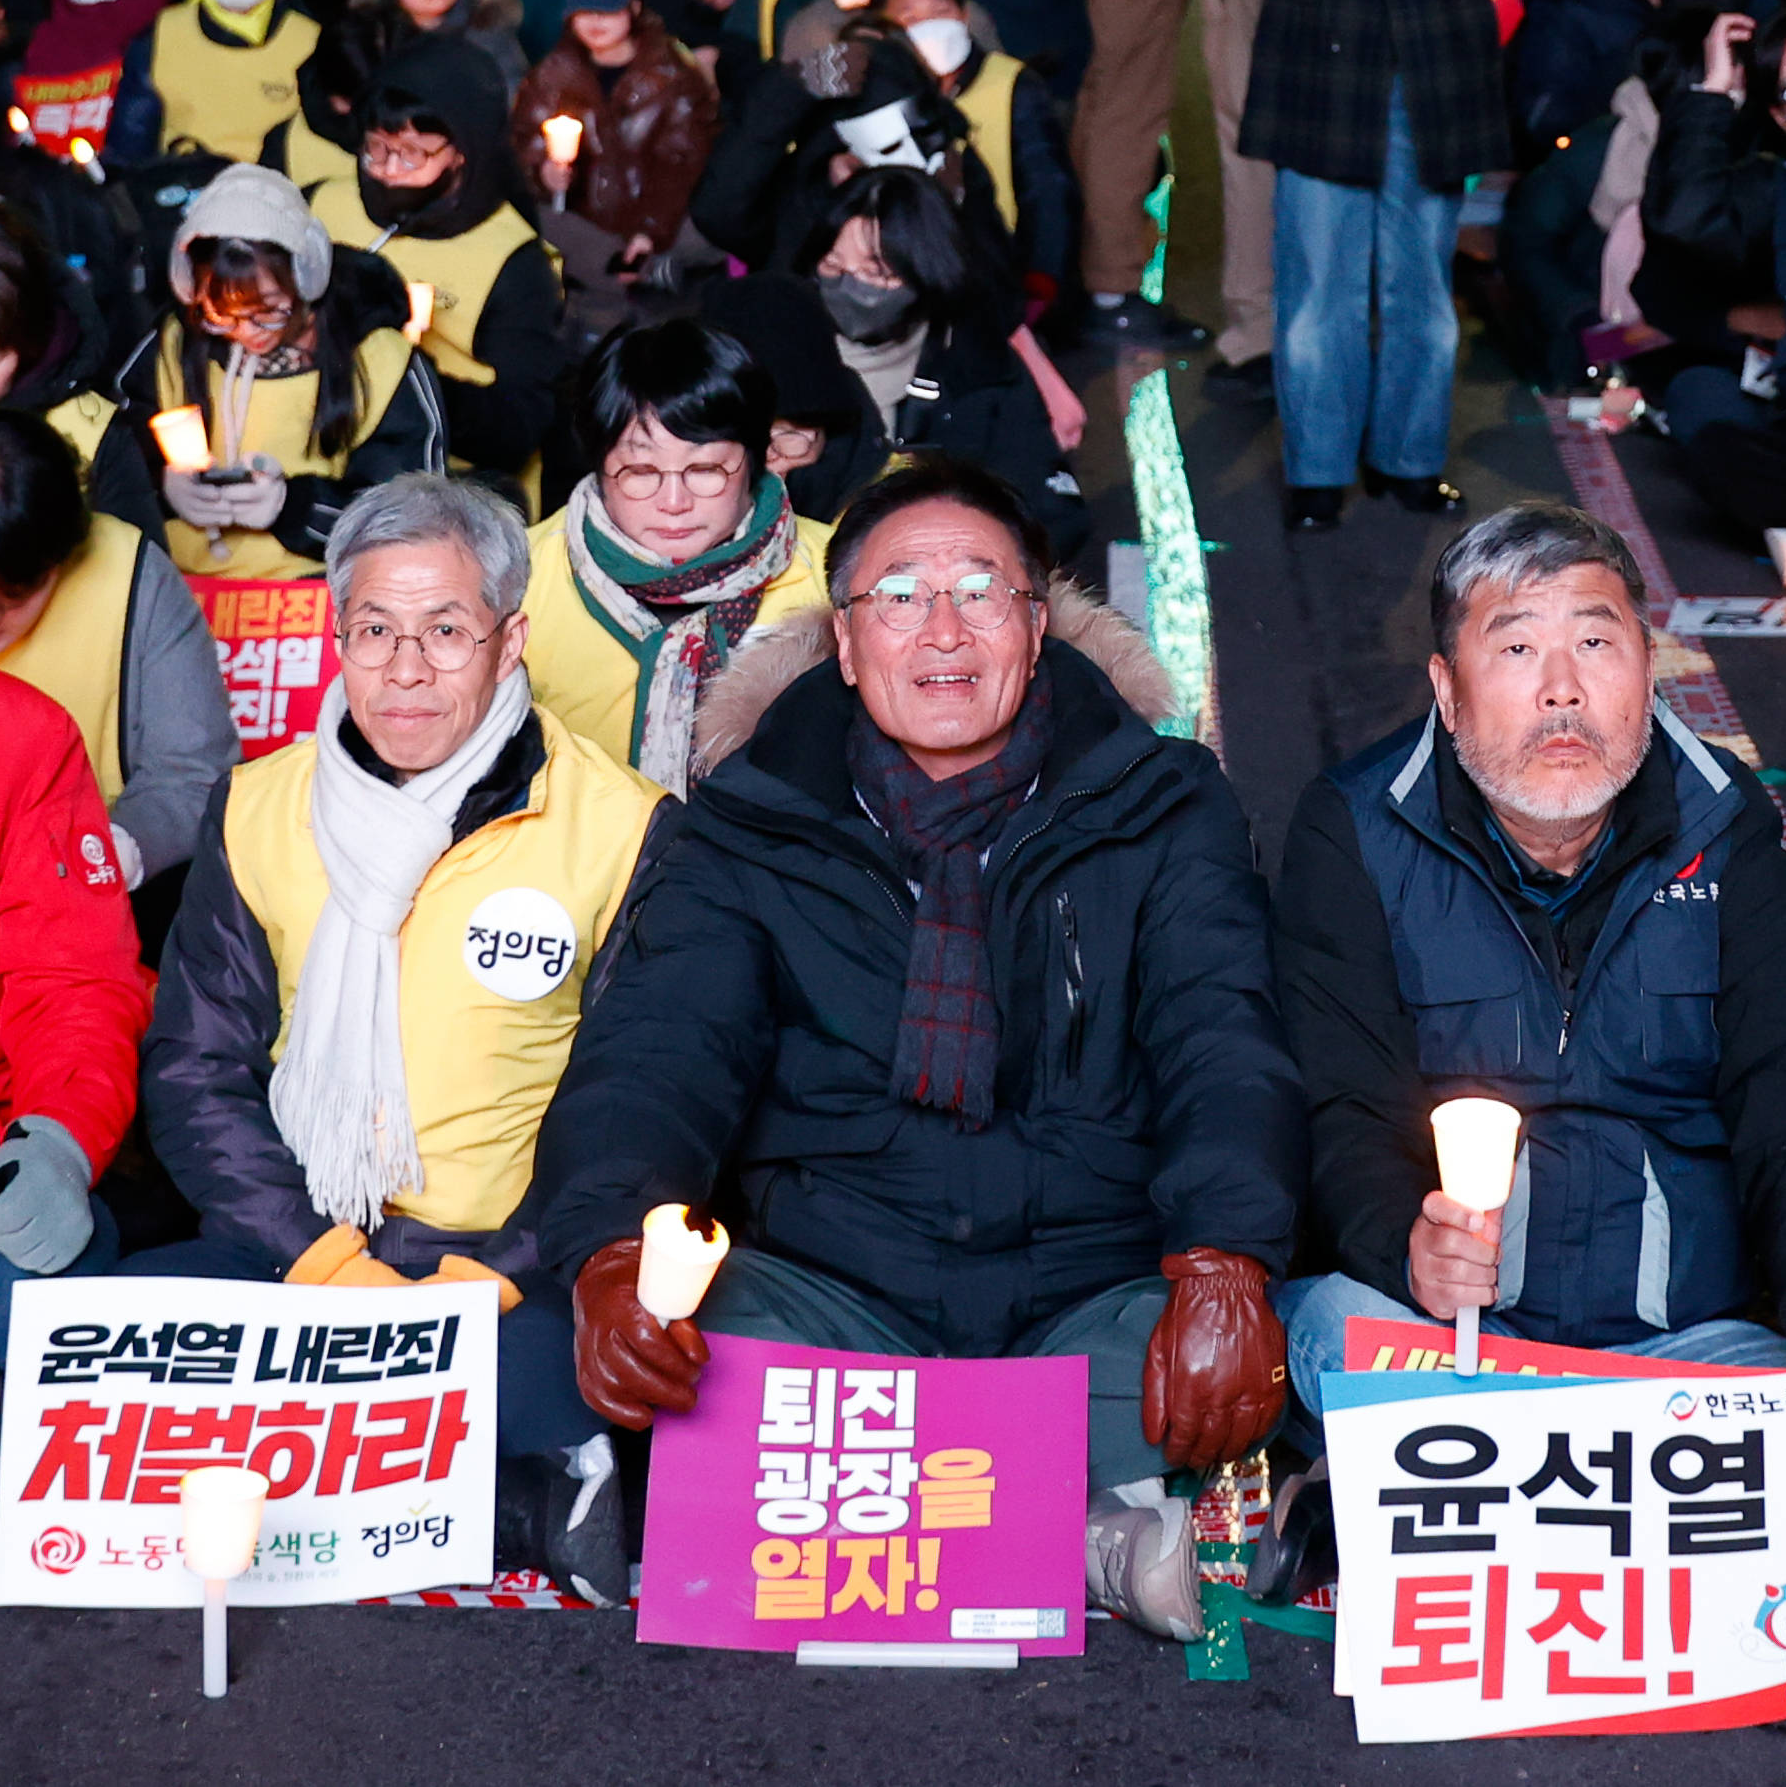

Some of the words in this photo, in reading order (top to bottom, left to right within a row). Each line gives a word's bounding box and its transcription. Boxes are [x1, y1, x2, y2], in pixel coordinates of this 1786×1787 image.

[230, 688, 290, 740] 진!
[468, 926, 571, 977] 정의당
[38, 1322, 245, 1385] 윤석열
[253, 1314, 462, 1383] 내란죄
[18, 1388, 470, 1505] 처벌하라
[757, 1366, 917, 1450] 퇴진
[754, 1447, 996, 1535] 광장을
[1378, 1424, 1769, 1558] 윤석열
[361, 1514, 455, 1558] 정의당
[750, 1536, 941, 1620] 열자!
[1381, 1565, 1694, 1701] 퇴진!
